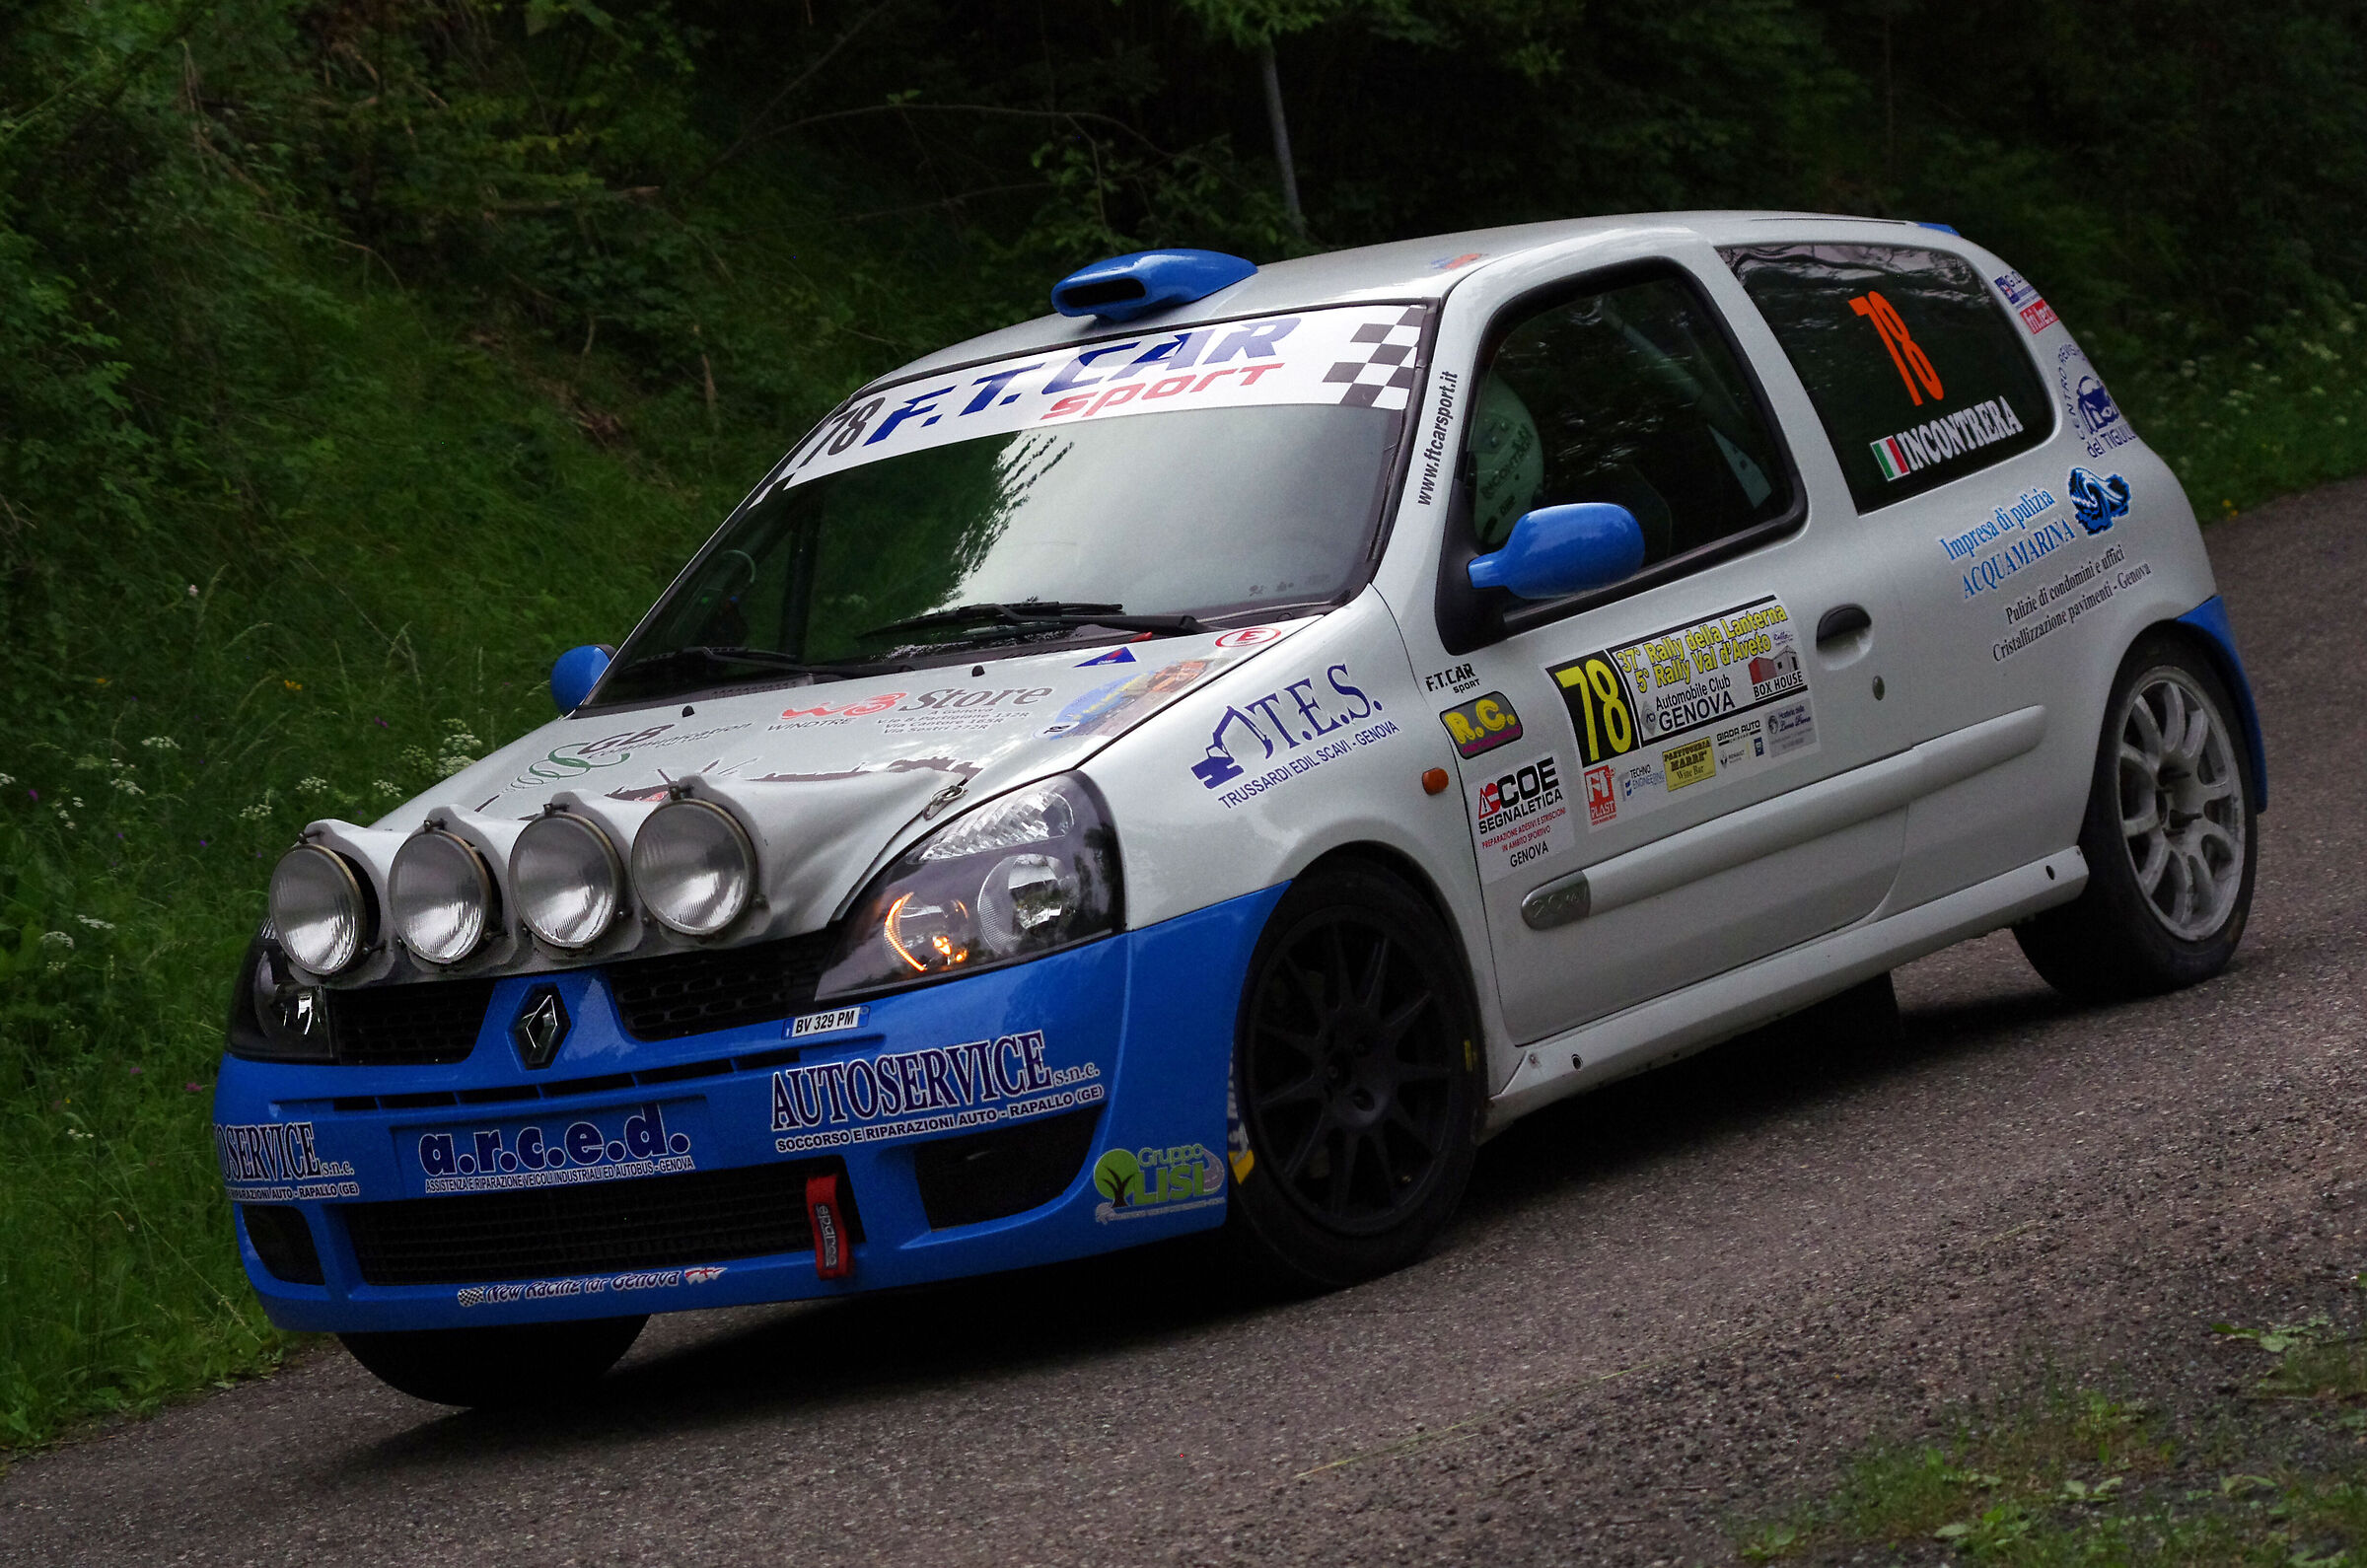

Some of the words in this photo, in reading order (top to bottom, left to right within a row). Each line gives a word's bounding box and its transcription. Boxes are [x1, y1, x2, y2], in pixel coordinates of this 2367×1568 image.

[1848, 291, 1944, 406] 78
[1040, 363, 1284, 420] sport
[800, 396, 886, 467] 78
[1418, 371, 1459, 506] www.ftcarsport.it
[1896, 395, 2025, 471] INCONTRERA
[2087, 438, 2106, 459] del
[1940, 521, 1999, 560] Impresa
[1994, 506, 2015, 531] di
[2010, 488, 2055, 530] pulizia
[1963, 519, 2075, 599] ACQUAMARINA
[2006, 597, 2038, 624] Pulizie
[2039, 588, 2049, 606] di
[2049, 560, 2095, 602] condomini
[2103, 544, 2125, 570] uffici
[1993, 610, 2067, 662] Cristallizzazione
[2068, 581, 2114, 624] pavimenti
[2117, 562, 2151, 590] Genova
[1643, 636, 1686, 664] Rally
[1686, 624, 1723, 651] della
[1720, 605, 1788, 638] Lanterna
[1653, 657, 1691, 687] Rally
[1691, 645, 1717, 674] Val
[1720, 632, 1771, 665] d'Aveto
[897, 687, 1052, 712] Store
[1454, 679, 1479, 693] sport
[1656, 681, 1708, 711] Automobile
[1709, 675, 1731, 692] Club
[1753, 681, 1772, 698] BOX
[1774, 671, 1803, 691] HOUSE
[766, 717, 855, 732] WINDTRE
[1245, 664, 1383, 749] T.E.S.
[1444, 699, 1516, 744] R.C.
[1555, 658, 1631, 762] 78
[1659, 690, 1736, 731] GENOVA
[1716, 727, 1740, 742] GIADA
[1741, 719, 1760, 733] AUTO
[1218, 764, 1292, 810] TRUSSARDI
[1291, 753, 1321, 777] EDIL
[1316, 739, 1353, 763] SCAVI
[1354, 720, 1399, 747] GENOVA
[1630, 764, 1651, 778] TECHNO
[1479, 789, 1563, 834] SEGNALETICA
[1591, 801, 1614, 819] PLAST
[1482, 827, 1518, 849] PREPARAZIONE
[1519, 819, 1538, 834] ADESIVI
[1508, 835, 1528, 850] AMBITO
[1528, 825, 1551, 843] SPORTIVO
[1510, 843, 1548, 868] GENOVA
[796, 1018, 812, 1033] BV
[815, 1014, 834, 1030] 329
[837, 1011, 855, 1026] PM
[771, 1030, 1053, 1130] AUTOSERVICE
[1053, 1062, 1100, 1087] s.n.c.
[418, 1103, 690, 1176] a.r.c.e.d.
[776, 1131, 850, 1153] SOCCORSO
[852, 1128, 863, 1143] E
[864, 1115, 955, 1140] RIPARAZIONI
[959, 1108, 998, 1128] AUTO
[1007, 1093, 1074, 1118] RAPALLO
[1076, 1085, 1105, 1104] (GE)
[322, 1161, 355, 1176] s.n.c.
[425, 1176, 468, 1193] ASSISTENZA
[474, 1175, 524, 1190] RIPARAZIONE
[523, 1172, 553, 1187] VEICOLI
[553, 1166, 604, 1183] INDUSTRIALI
[603, 1165, 615, 1179] ED
[614, 1161, 653, 1178] AUTOBUS
[659, 1156, 695, 1175] GENOVA
[1137, 1143, 1204, 1170] Gruppo
[271, 1186, 293, 1200] AUTO
[299, 1184, 338, 1199] RAPALLO
[338, 1182, 360, 1197] (GE)
[1134, 1163, 1205, 1206] LISI
[486, 1285, 524, 1303] New
[525, 1279, 583, 1300] Racing
[584, 1276, 609, 1293] for
[610, 1271, 681, 1291] Genova
